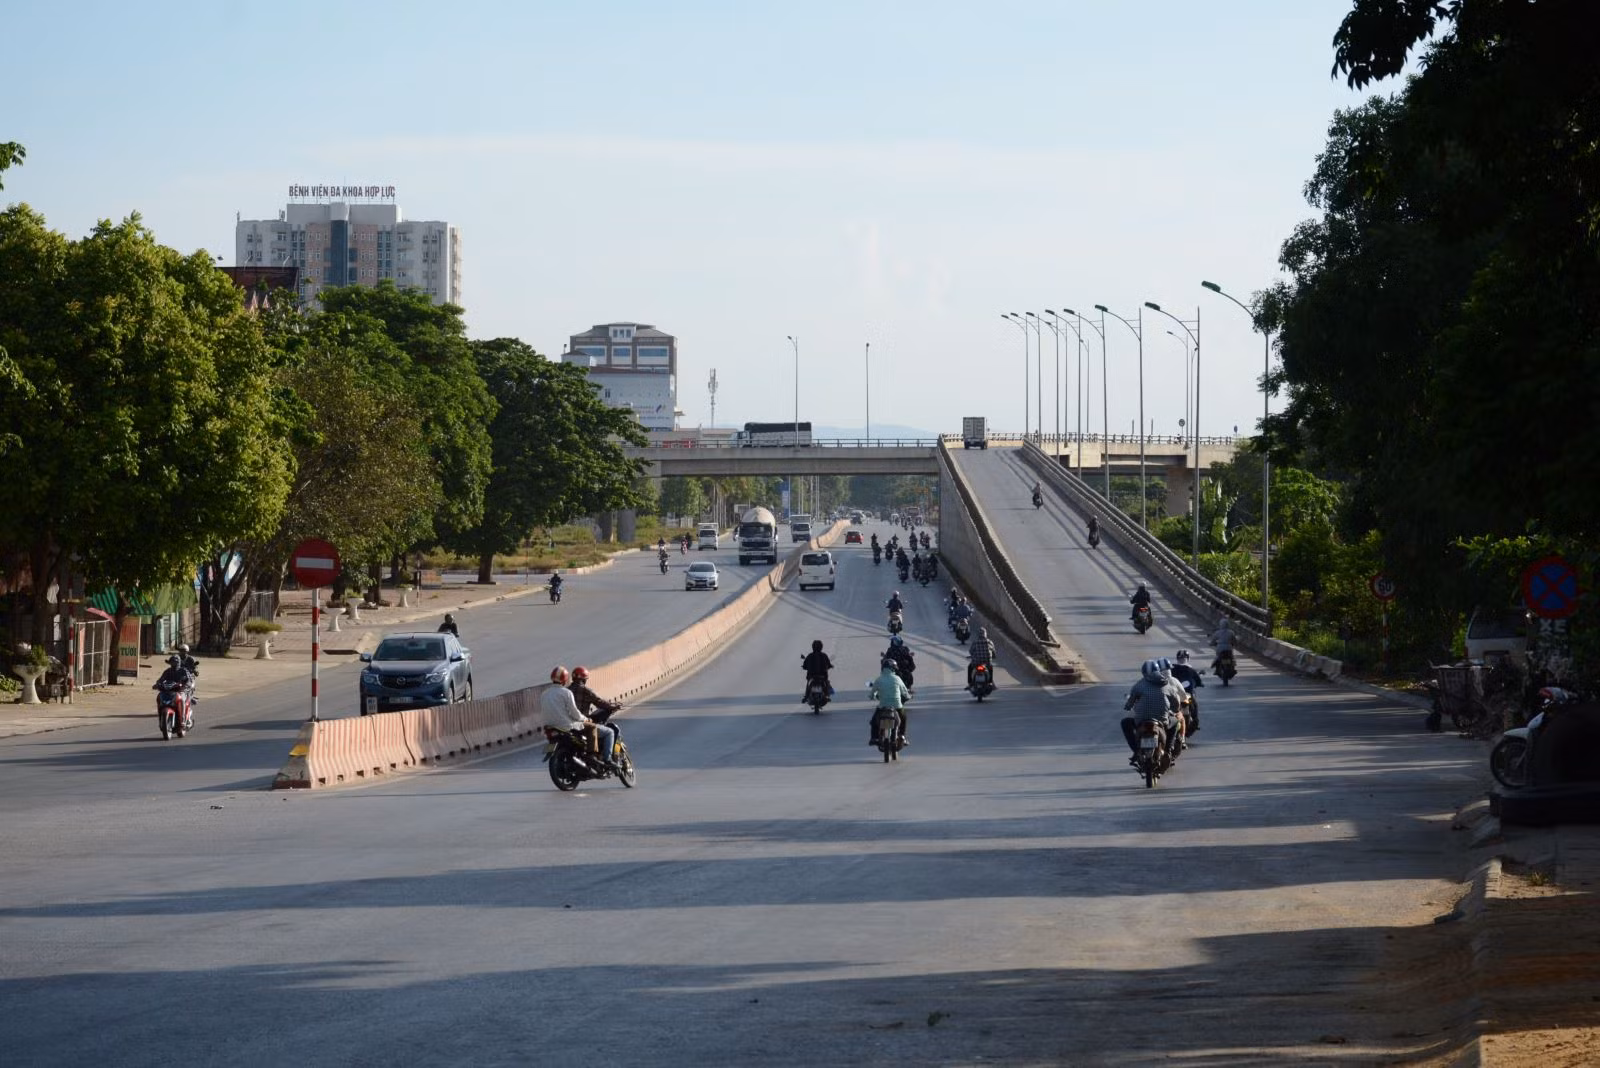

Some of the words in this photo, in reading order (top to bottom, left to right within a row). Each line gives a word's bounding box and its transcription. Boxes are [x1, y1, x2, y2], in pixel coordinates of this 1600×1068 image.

[289, 184, 309, 199] BỆNH
[312, 184, 329, 199] VIỆN
[331, 186, 340, 197] ĐA
[342, 186, 362, 197] KHOA
[364, 186, 380, 199] HỢP
[381, 185, 395, 199] LỰC
[1539, 618, 1567, 633] XE
